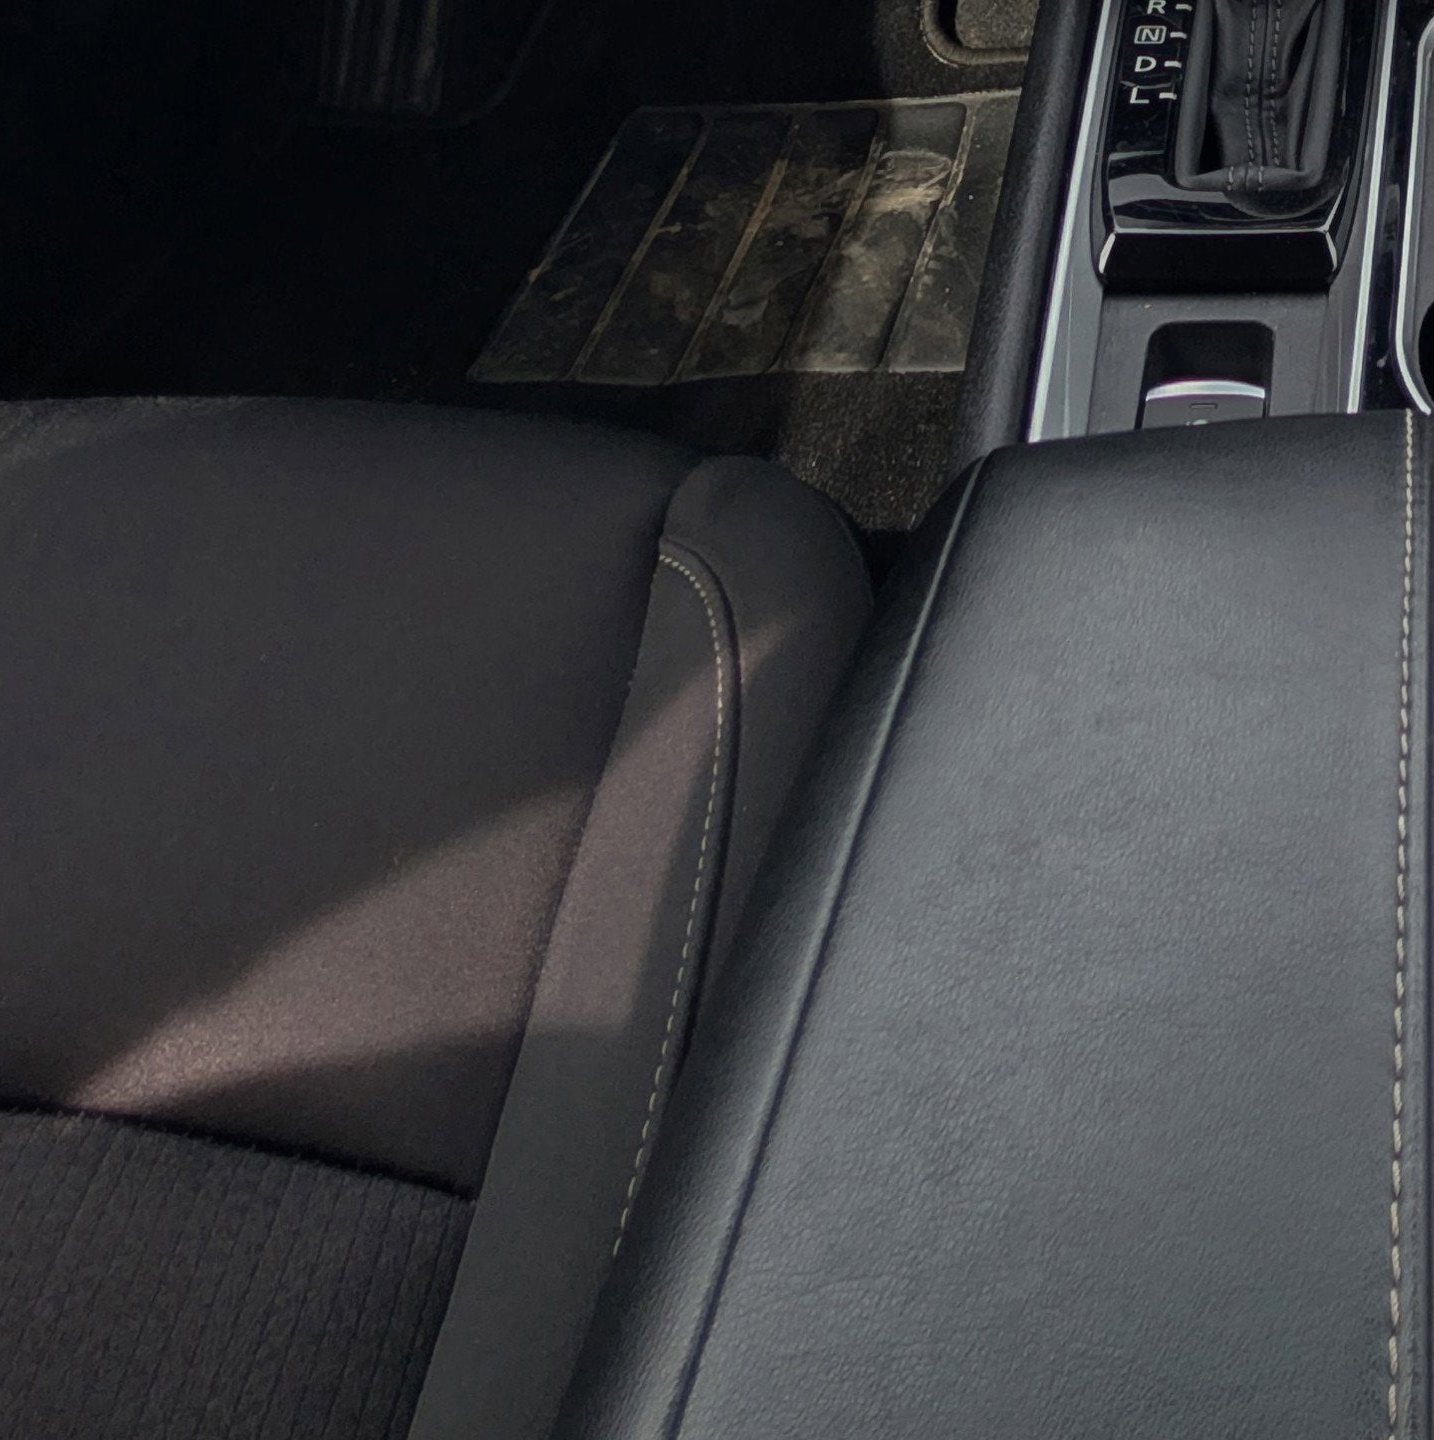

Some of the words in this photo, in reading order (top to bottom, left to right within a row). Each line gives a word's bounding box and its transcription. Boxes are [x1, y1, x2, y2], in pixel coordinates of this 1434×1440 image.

[1147, 0, 1166, 14] R
[1141, 28, 1161, 43] N
[1134, 56, 1158, 72] D
[1129, 88, 1150, 104] L
